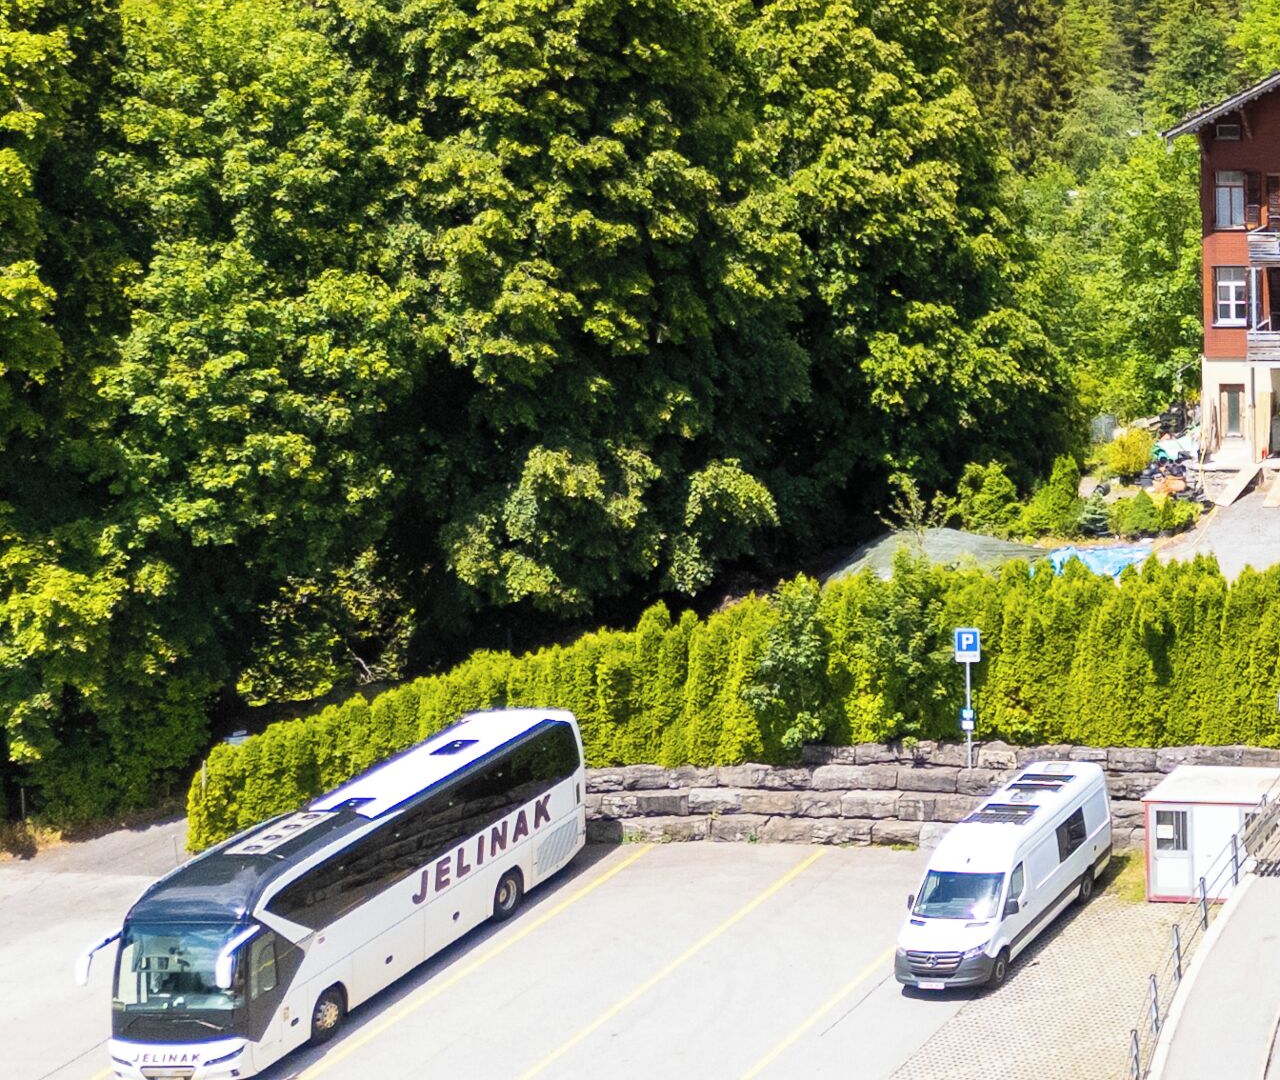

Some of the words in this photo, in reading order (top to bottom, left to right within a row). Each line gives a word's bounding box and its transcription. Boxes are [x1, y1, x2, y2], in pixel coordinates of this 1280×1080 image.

[962, 633, 974, 650] P
[411, 793, 552, 905] JELINAK
[132, 1053, 201, 1063] JELINAK
